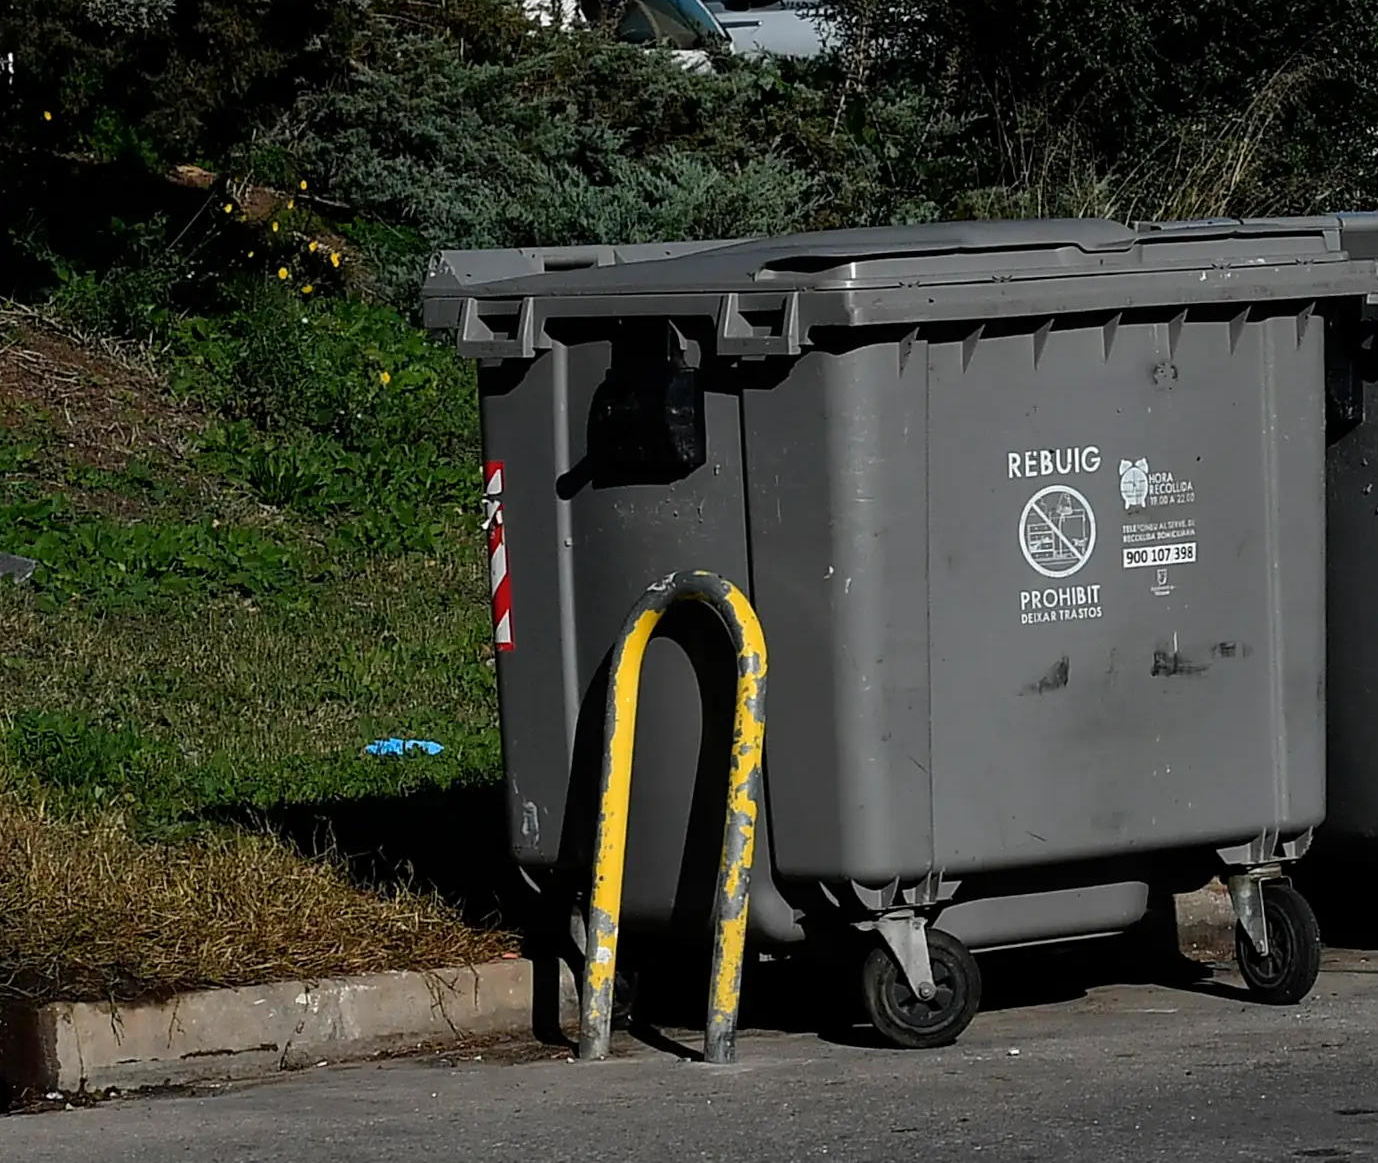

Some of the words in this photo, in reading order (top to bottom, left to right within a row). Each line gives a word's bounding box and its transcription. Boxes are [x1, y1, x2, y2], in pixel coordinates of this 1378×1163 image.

[1008, 446, 1101, 479] REBUIG
[1148, 472, 1173, 484] HORA
[1149, 481, 1194, 495] RECOLLIDA
[1169, 495, 1175, 504] A
[1126, 549, 1148, 565] 900
[1151, 547, 1171, 563] 107
[1174, 545, 1194, 560] 398
[1020, 585, 1101, 611] PROHIBIT
[1021, 611, 1057, 625] DEIXAR
[1059, 606, 1102, 621] TRASTOS
